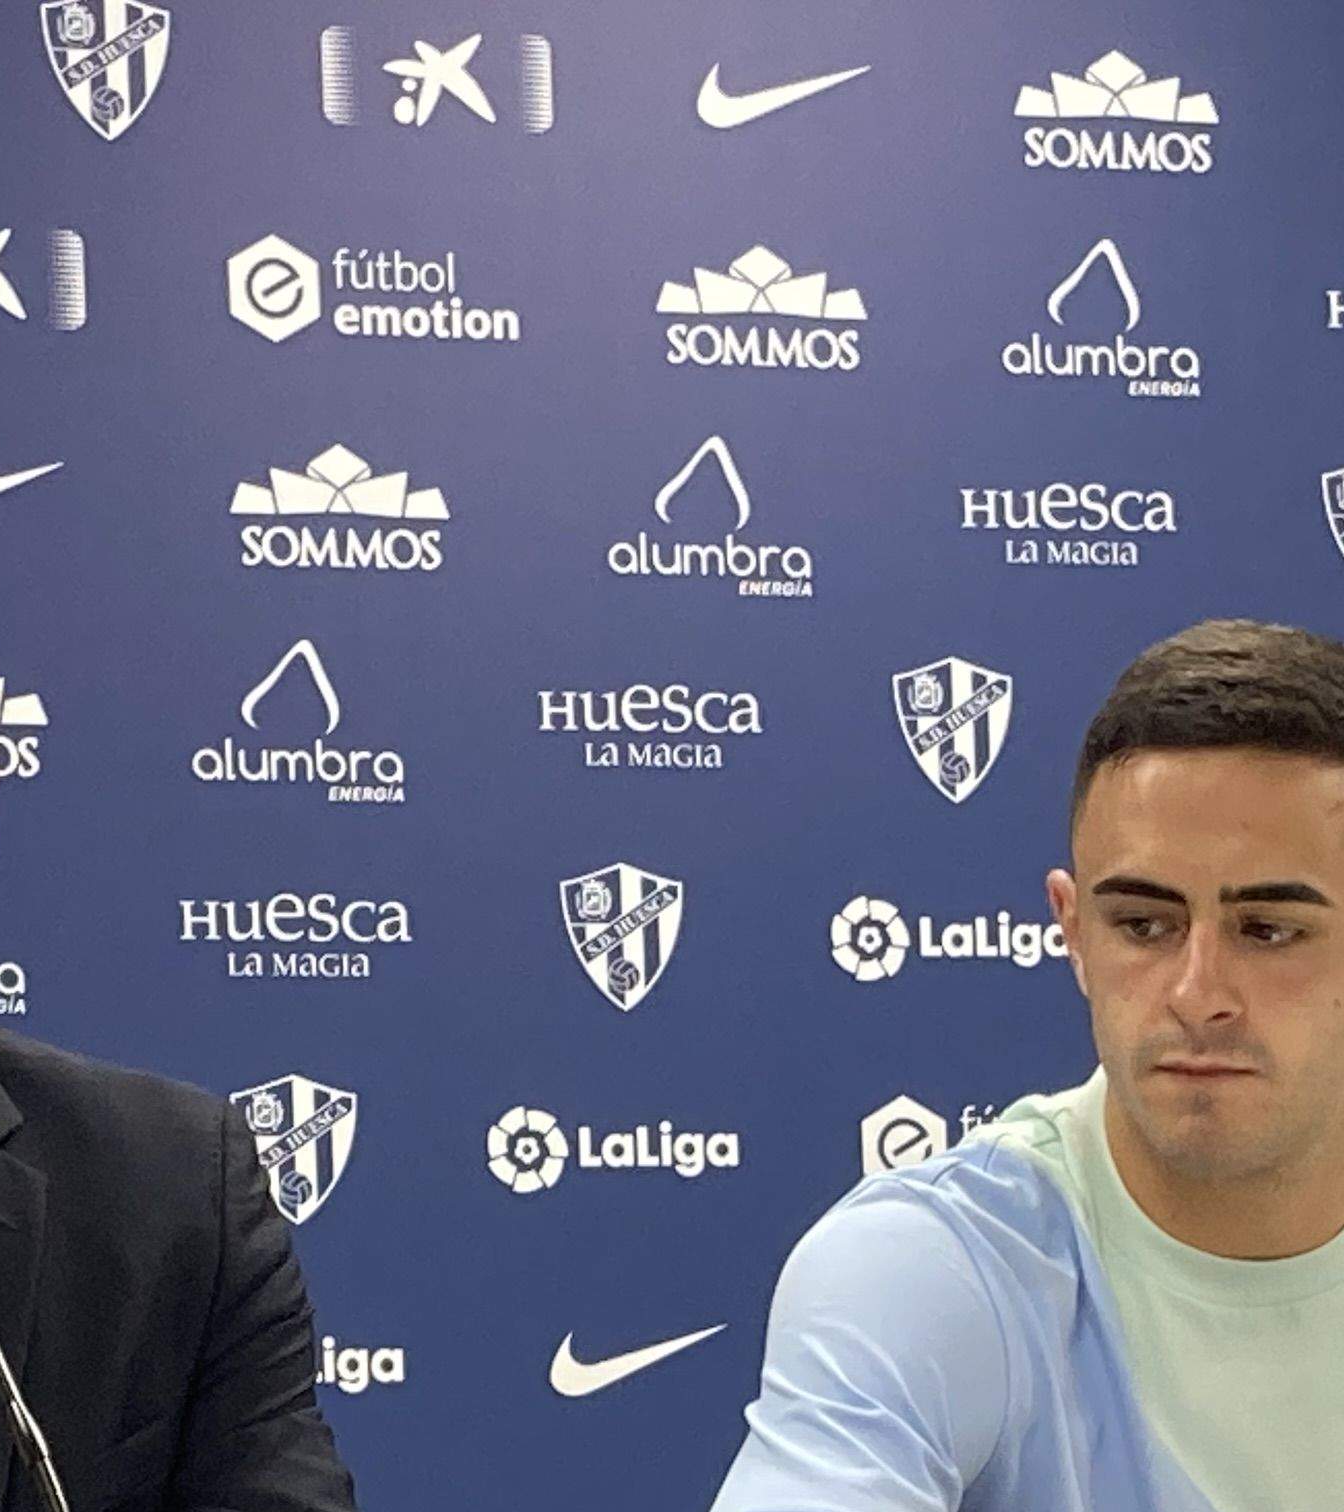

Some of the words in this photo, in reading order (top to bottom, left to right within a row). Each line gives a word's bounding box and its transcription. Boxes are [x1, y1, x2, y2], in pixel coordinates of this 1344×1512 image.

[1024, 126, 1212, 173] SOMMOS
[331, 247, 455, 294] fútbol
[333, 300, 520, 342] emotion
[666, 323, 860, 371] SOMMOS
[1002, 332, 1200, 379] alumbra
[241, 525, 443, 571] SOMMOS
[608, 531, 812, 579] alumbra
[191, 737, 404, 784] alumbra
[578, 1120, 739, 1172] LaLiga
[316, 1335, 405, 1394] iga
